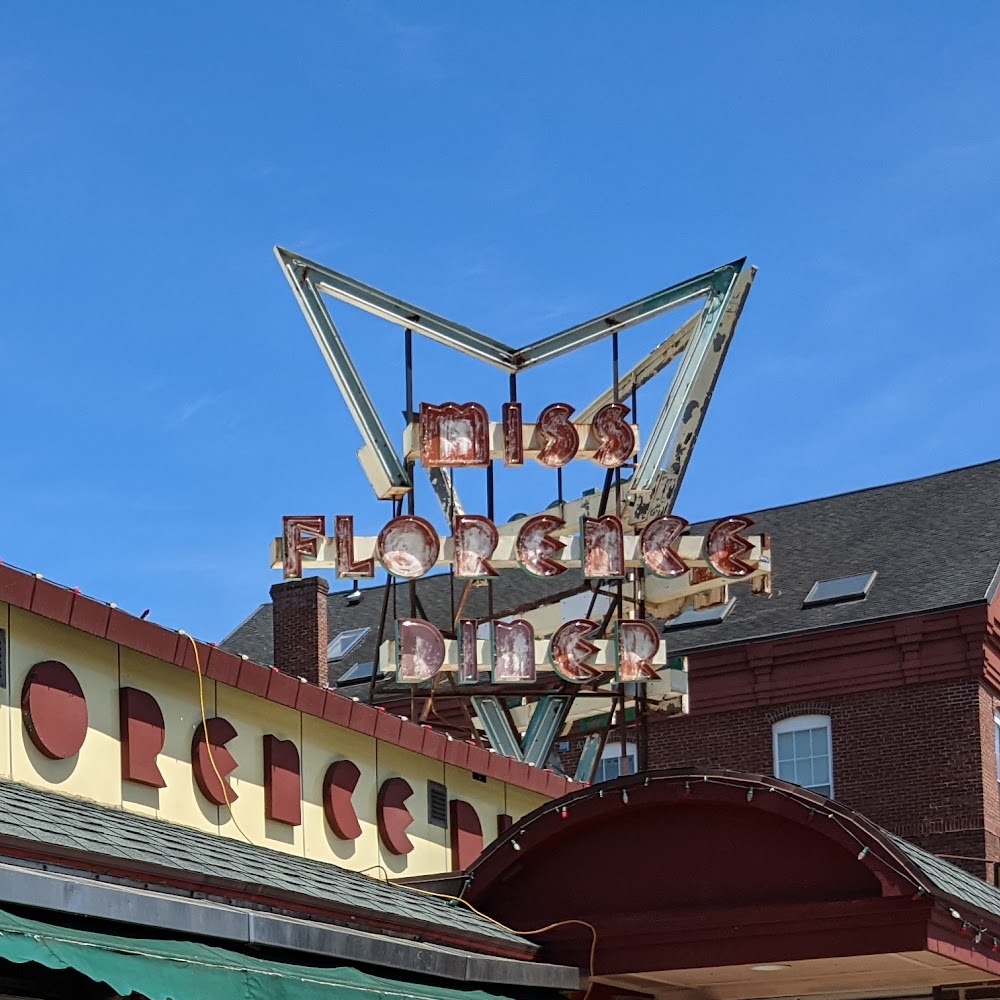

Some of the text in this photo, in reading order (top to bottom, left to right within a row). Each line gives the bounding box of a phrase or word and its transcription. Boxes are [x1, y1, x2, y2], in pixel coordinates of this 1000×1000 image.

[419, 401, 635, 468] MISS
[282, 514, 757, 579] FLORENCE
[395, 618, 661, 684] DINER
